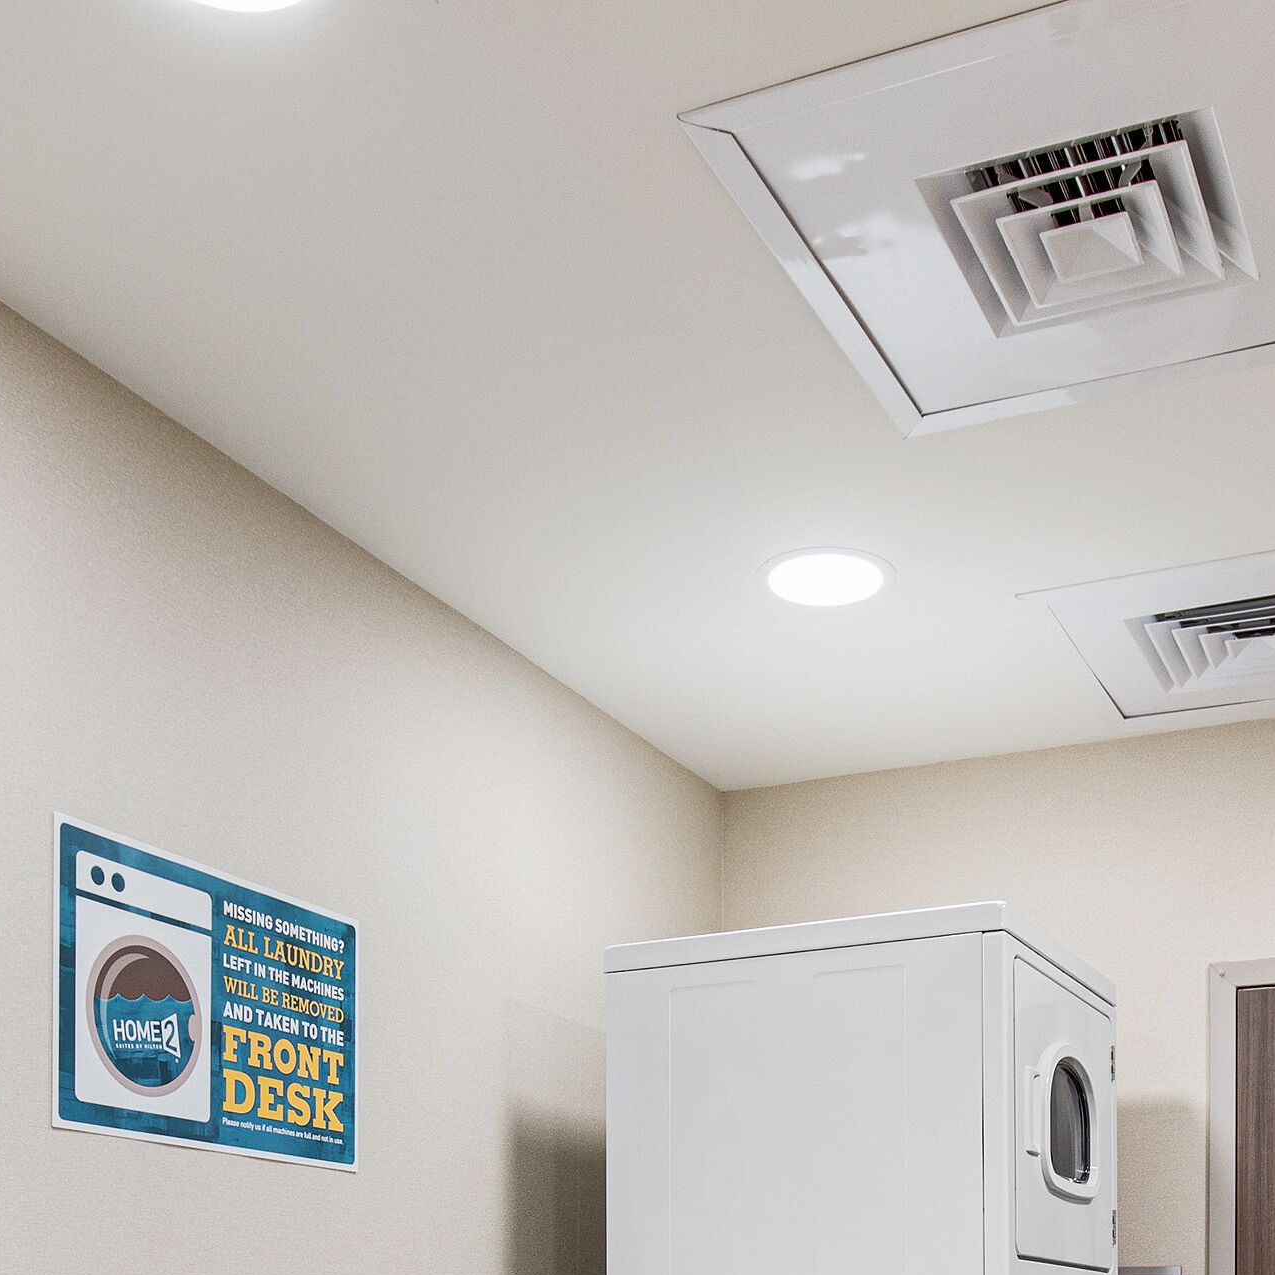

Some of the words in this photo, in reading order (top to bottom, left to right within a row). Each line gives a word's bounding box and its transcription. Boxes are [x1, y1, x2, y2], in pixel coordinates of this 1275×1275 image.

[223, 900, 273, 930] MISSING
[275, 918, 345, 954] SOMETHING?
[223, 924, 259, 955] ALL
[263, 936, 345, 980] LAUNDRY
[223, 952, 252, 974] LEFT
[254, 962, 266, 979] IN
[268, 966, 290, 986] THE
[291, 973, 345, 1001] MACHINES
[223, 975, 259, 1001] WILL
[262, 986, 279, 1006] BE
[281, 991, 345, 1024] REMOVED
[223, 1001, 253, 1024] AND
[255, 1008, 300, 1035] TAKEN
[302, 1020, 318, 1040] TO
[320, 1025, 345, 1047] THE
[222, 1024, 344, 1085] FRONT
[222, 1068, 344, 1132] DESK
[222, 1117, 240, 1127] Please
[240, 1121, 255, 1131] notify
[273, 1127, 295, 1137] machines
[304, 1131, 312, 1139] full
